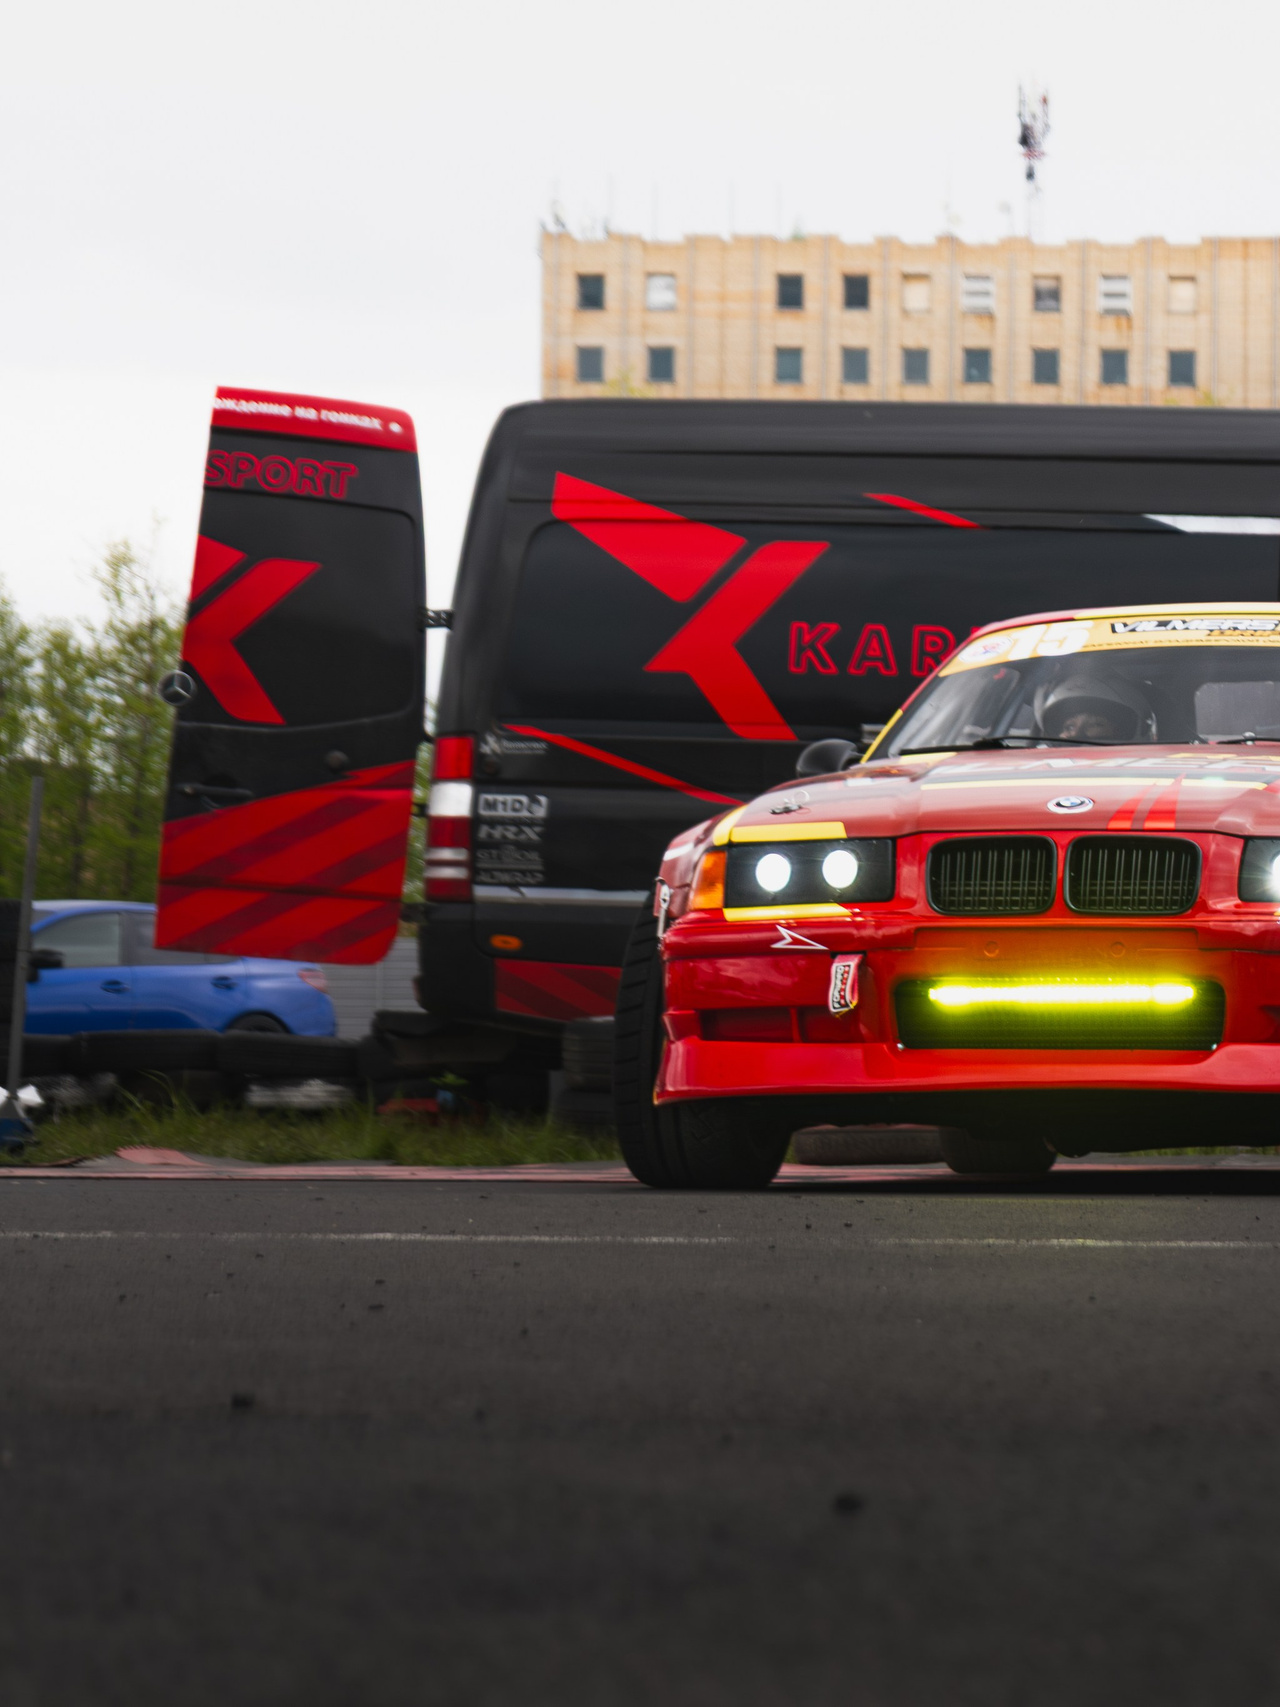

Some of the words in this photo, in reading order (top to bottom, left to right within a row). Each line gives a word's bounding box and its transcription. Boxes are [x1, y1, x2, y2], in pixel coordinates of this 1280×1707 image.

[204, 450, 359, 499] SPORT
[788, 620, 980, 677] KAR
[1008, 620, 1094, 660] 15
